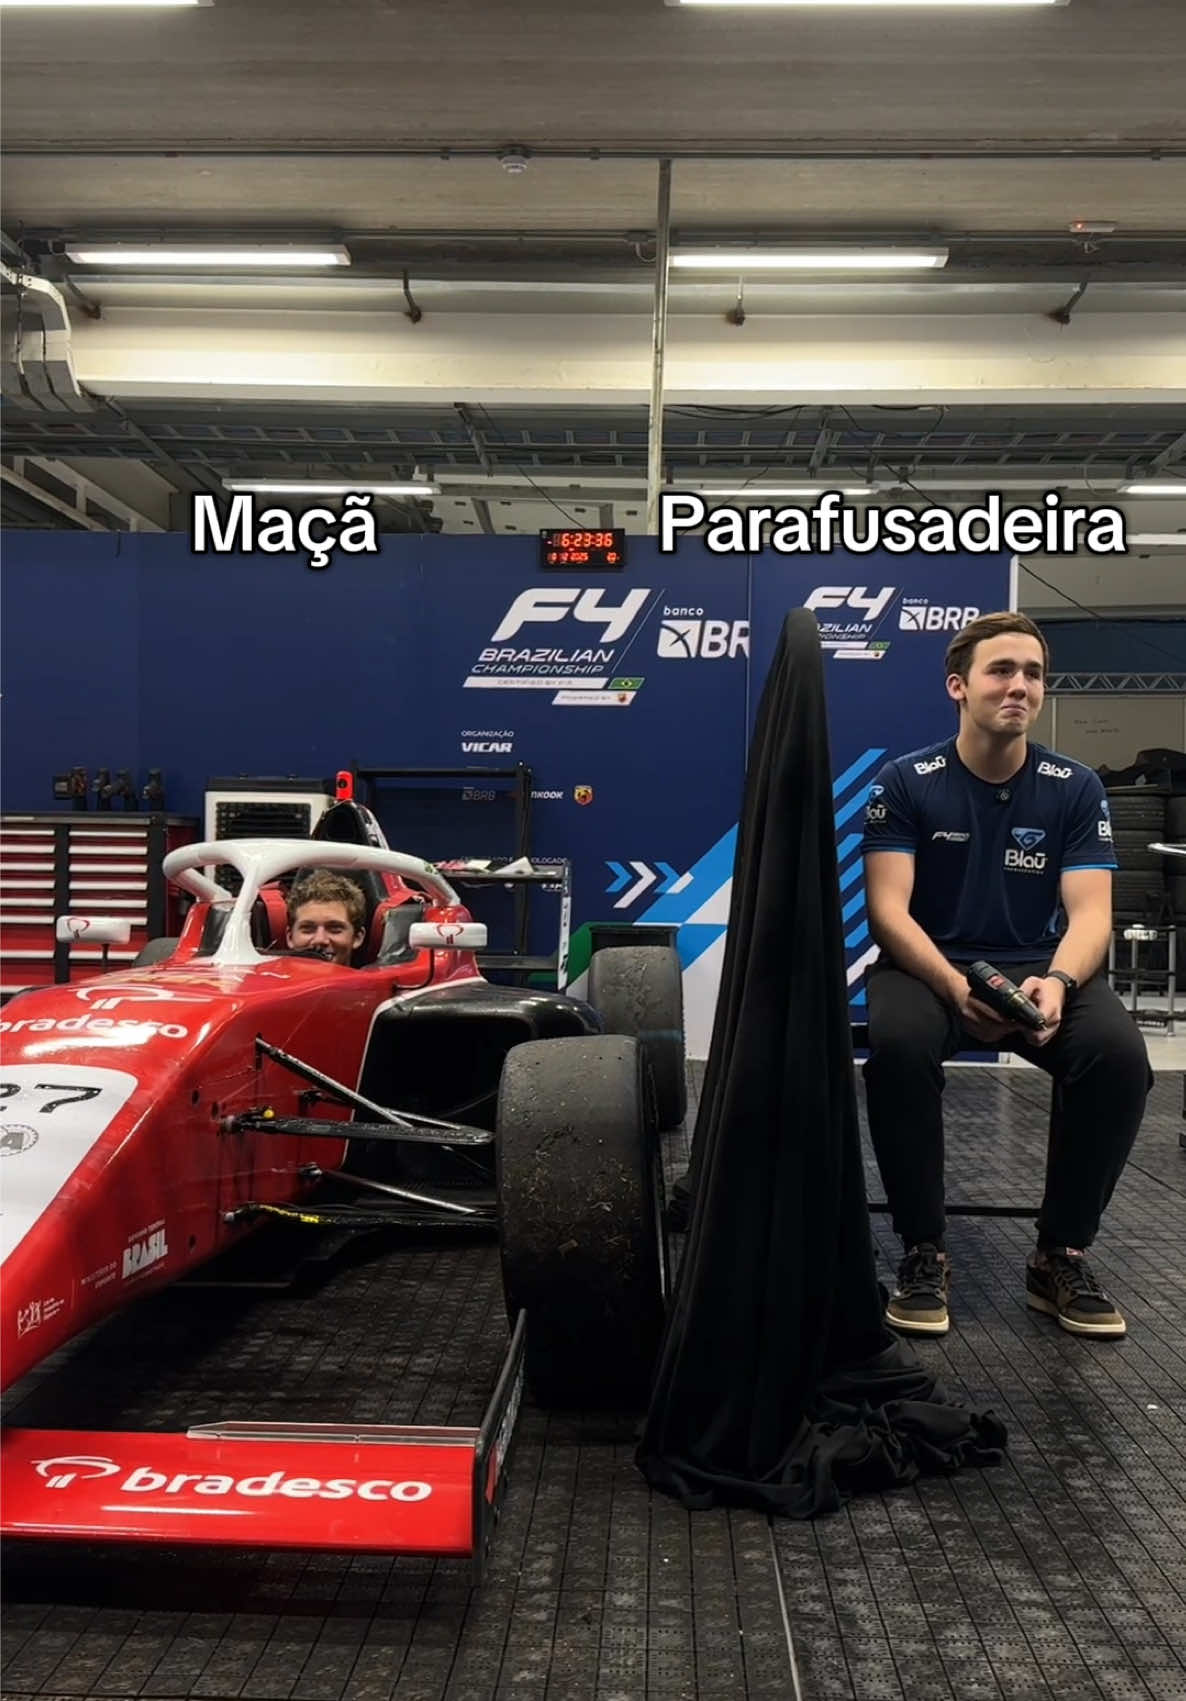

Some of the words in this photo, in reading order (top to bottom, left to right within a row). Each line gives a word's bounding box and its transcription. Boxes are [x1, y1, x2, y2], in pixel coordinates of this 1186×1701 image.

[803, 586, 896, 621] F4
[490, 587, 651, 643] F4
[663, 606, 704, 616] banco
[816, 623, 872, 633] ZILIAN
[700, 620, 750, 658] BR
[478, 648, 615, 662] BRAZILIAN
[471, 664, 604, 674] CHAMPIONSHIP
[461, 742, 513, 752] VICAR
[530, 791, 564, 799] NKOOK
[120, 1467, 432, 1501] bradesco
